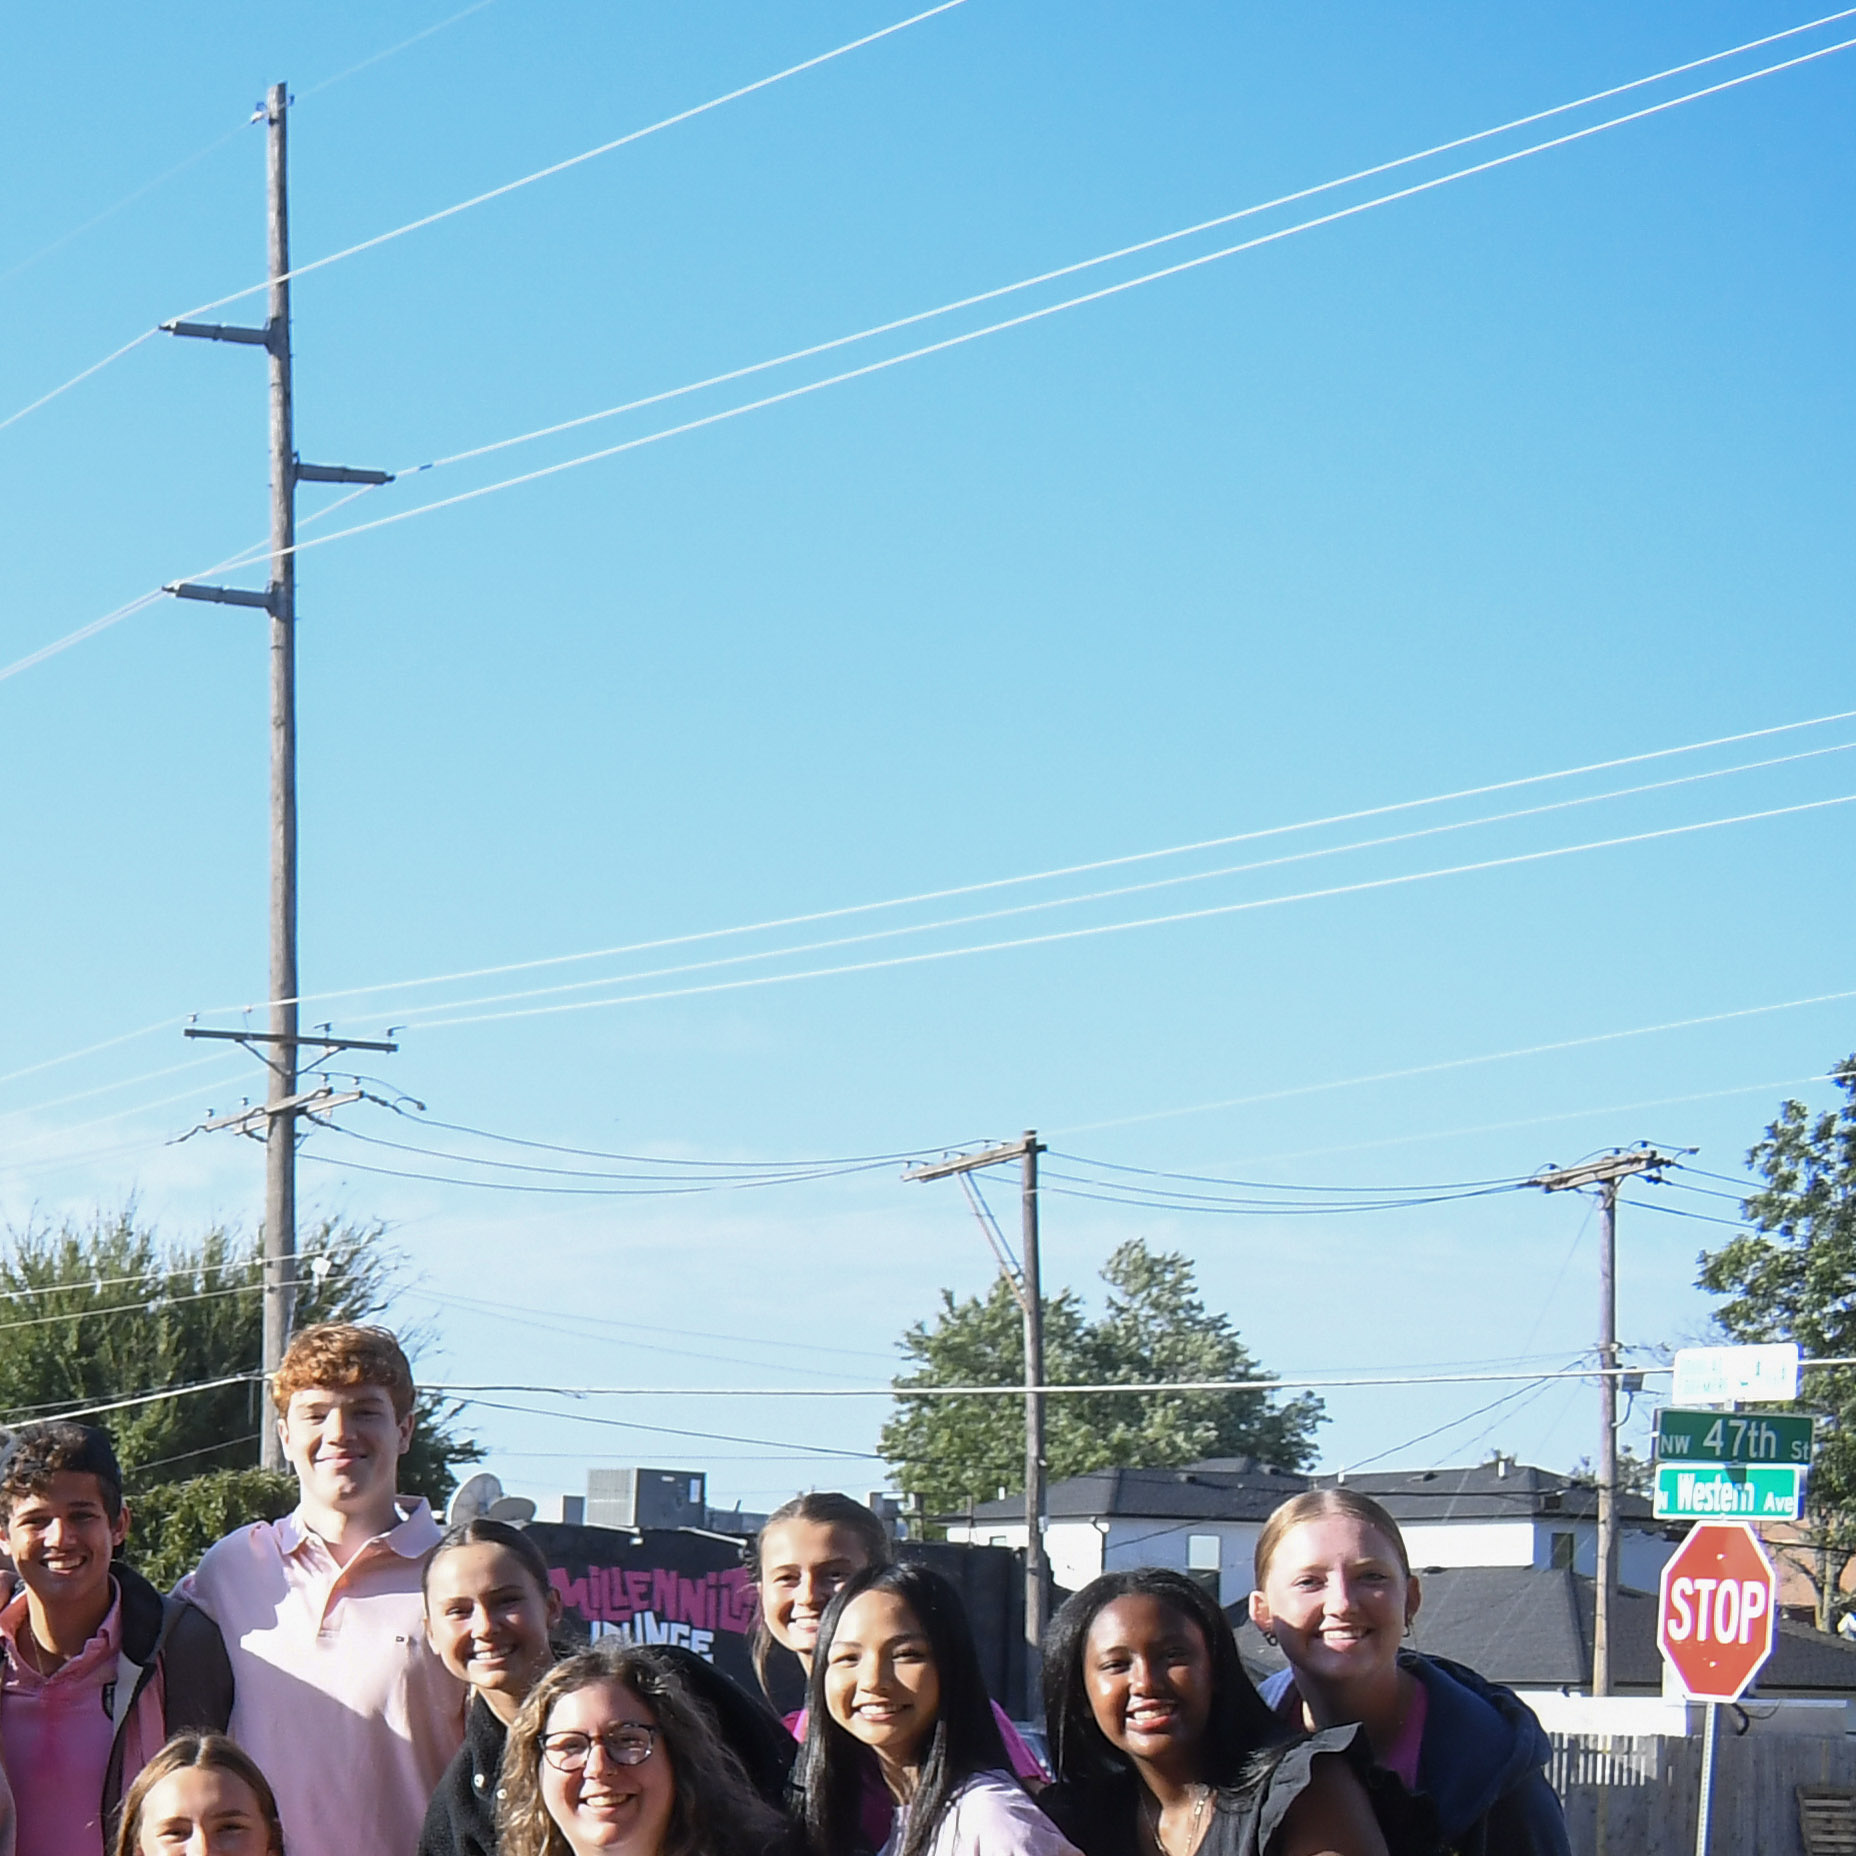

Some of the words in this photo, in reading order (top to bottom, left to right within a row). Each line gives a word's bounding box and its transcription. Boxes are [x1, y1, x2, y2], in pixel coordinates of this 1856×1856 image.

[1659, 1434, 1691, 1455] NW
[1702, 1418, 1777, 1460] 47th
[1790, 1440, 1810, 1461] St
[1658, 1490, 1669, 1511] N
[1677, 1472, 1755, 1512] Western
[1763, 1491, 1795, 1513] Ave
[1667, 1576, 1767, 1646] STOP
